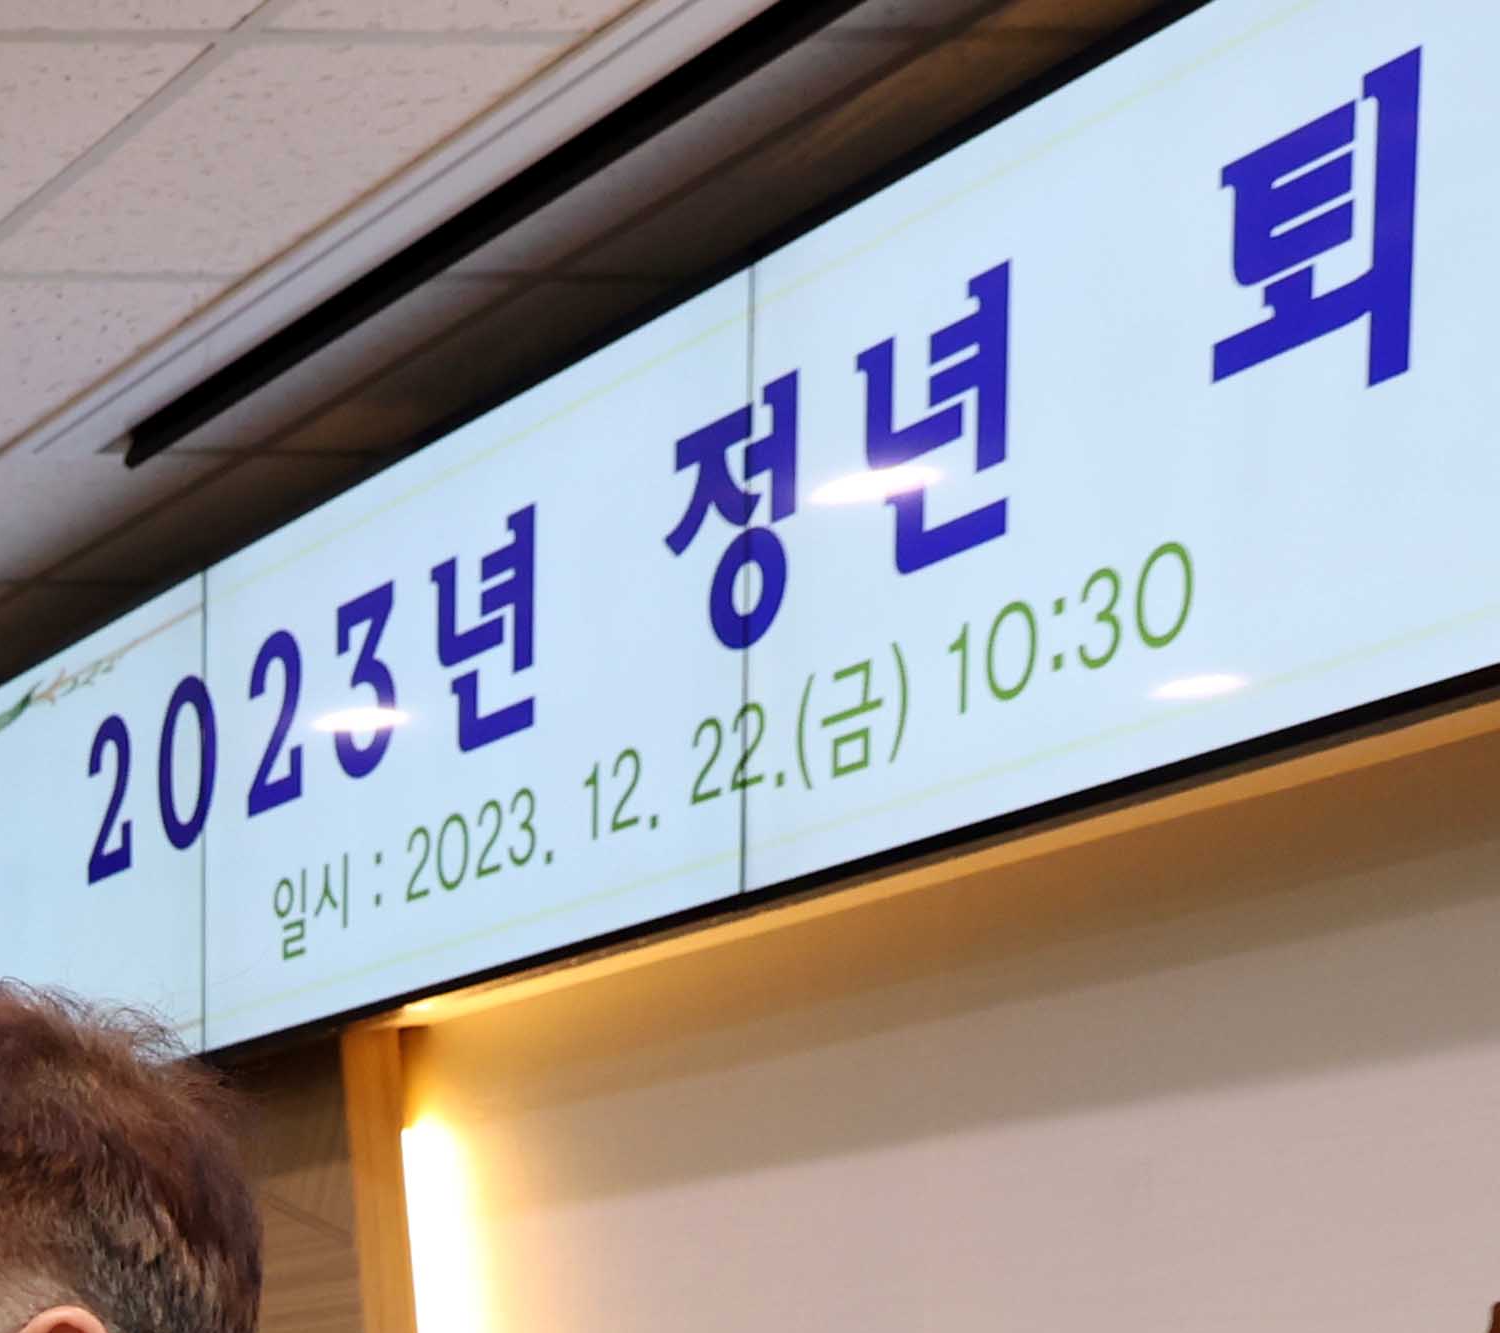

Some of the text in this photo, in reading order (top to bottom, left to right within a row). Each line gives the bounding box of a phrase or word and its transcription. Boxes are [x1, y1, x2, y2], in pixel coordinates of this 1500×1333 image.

[87, 45, 1423, 884] 2023년 정년 퇴
[274, 853, 349, 960] 일시
[406, 787, 554, 902] 2023.
[584, 748, 659, 840] 12.
[946, 540, 1195, 717] 10:30
